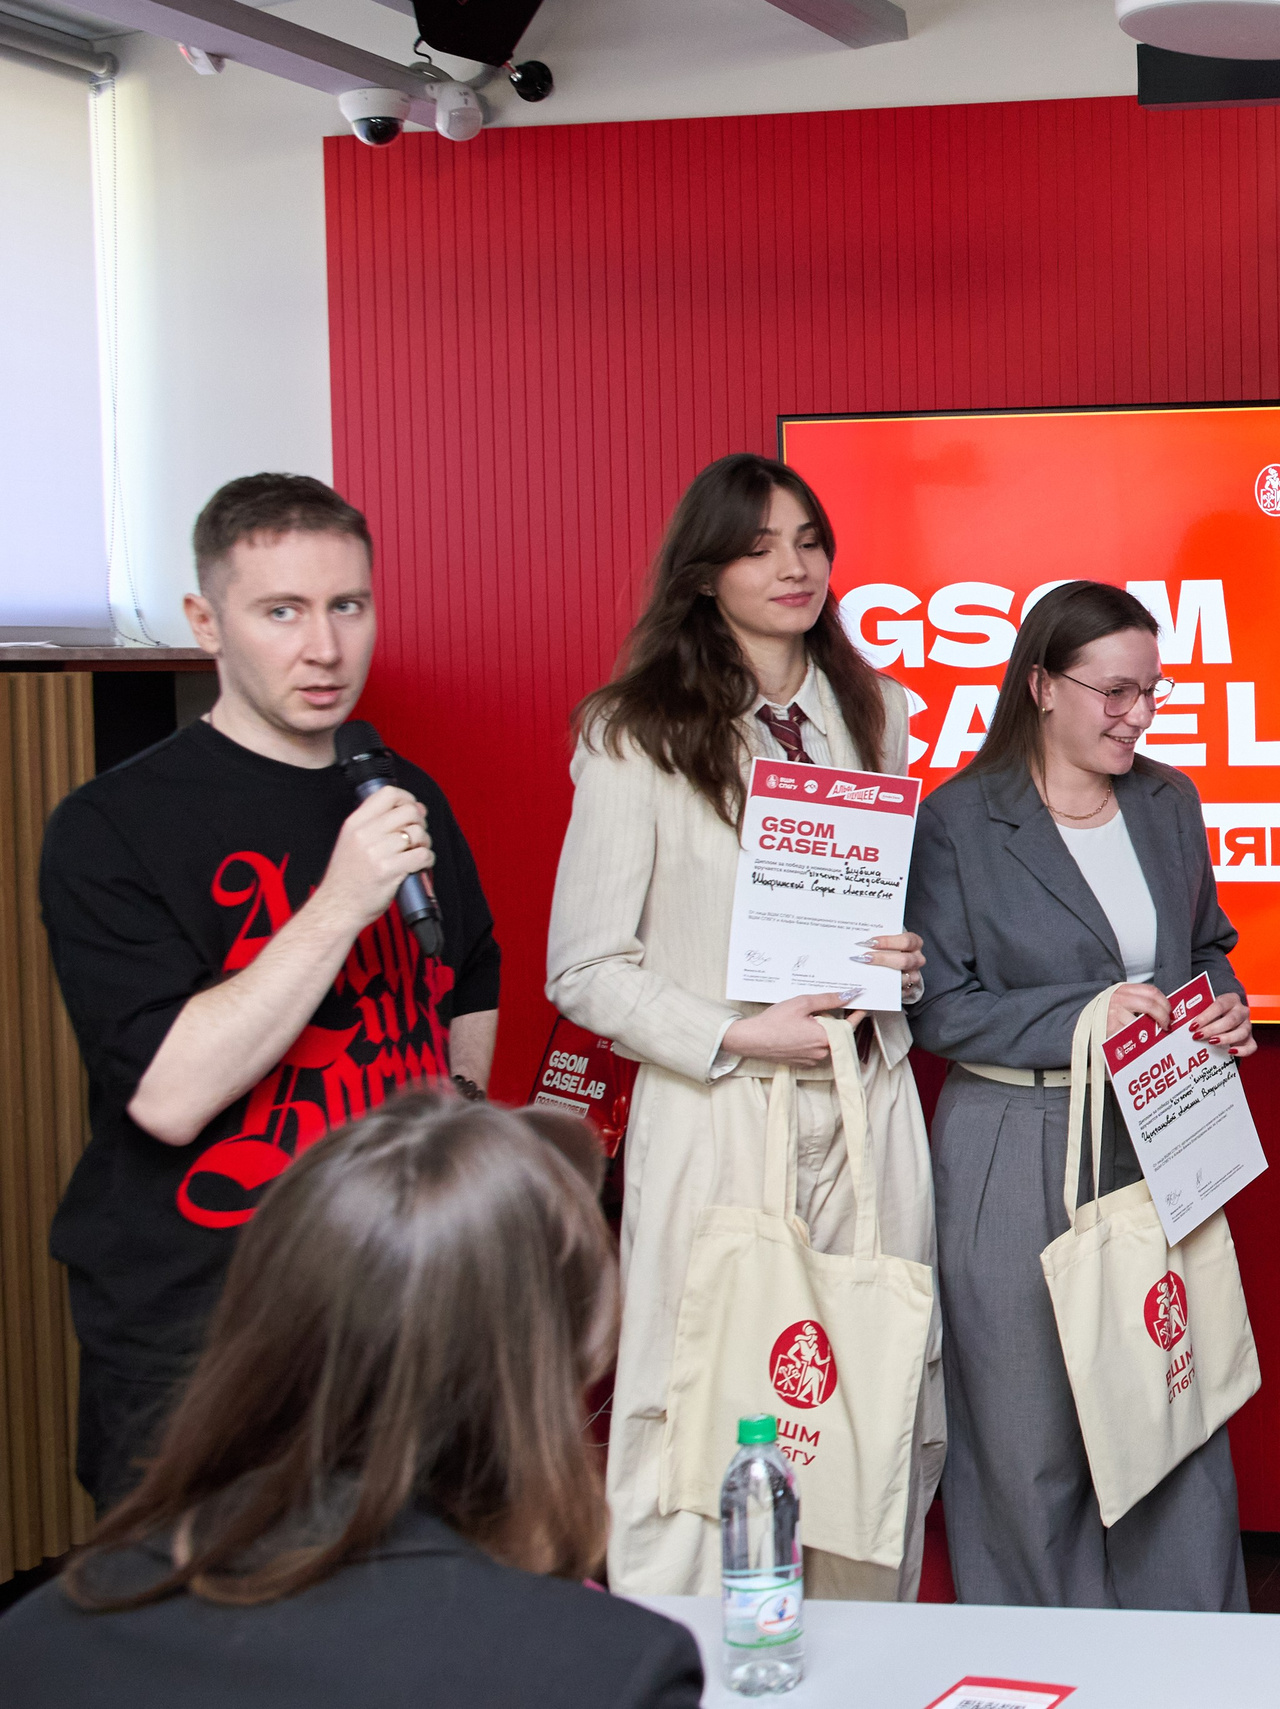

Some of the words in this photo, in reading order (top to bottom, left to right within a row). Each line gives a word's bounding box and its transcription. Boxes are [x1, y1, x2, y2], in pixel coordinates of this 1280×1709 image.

[839, 578, 1233, 669] GSM
[760, 815, 835, 838] GSOM
[758, 834, 827, 855] CASE
[831, 843, 879, 862] LAB
[548, 1050, 589, 1075] GSOM
[1127, 1052, 1175, 1096] GSOM
[542, 1069, 580, 1094] CASE
[576, 1077, 607, 1100] LAB
[1132, 1070, 1176, 1112] CASE
[1176, 1046, 1209, 1079] LAB
[776, 1418, 821, 1447] ШМ
[778, 1443, 817, 1466] бГУ
